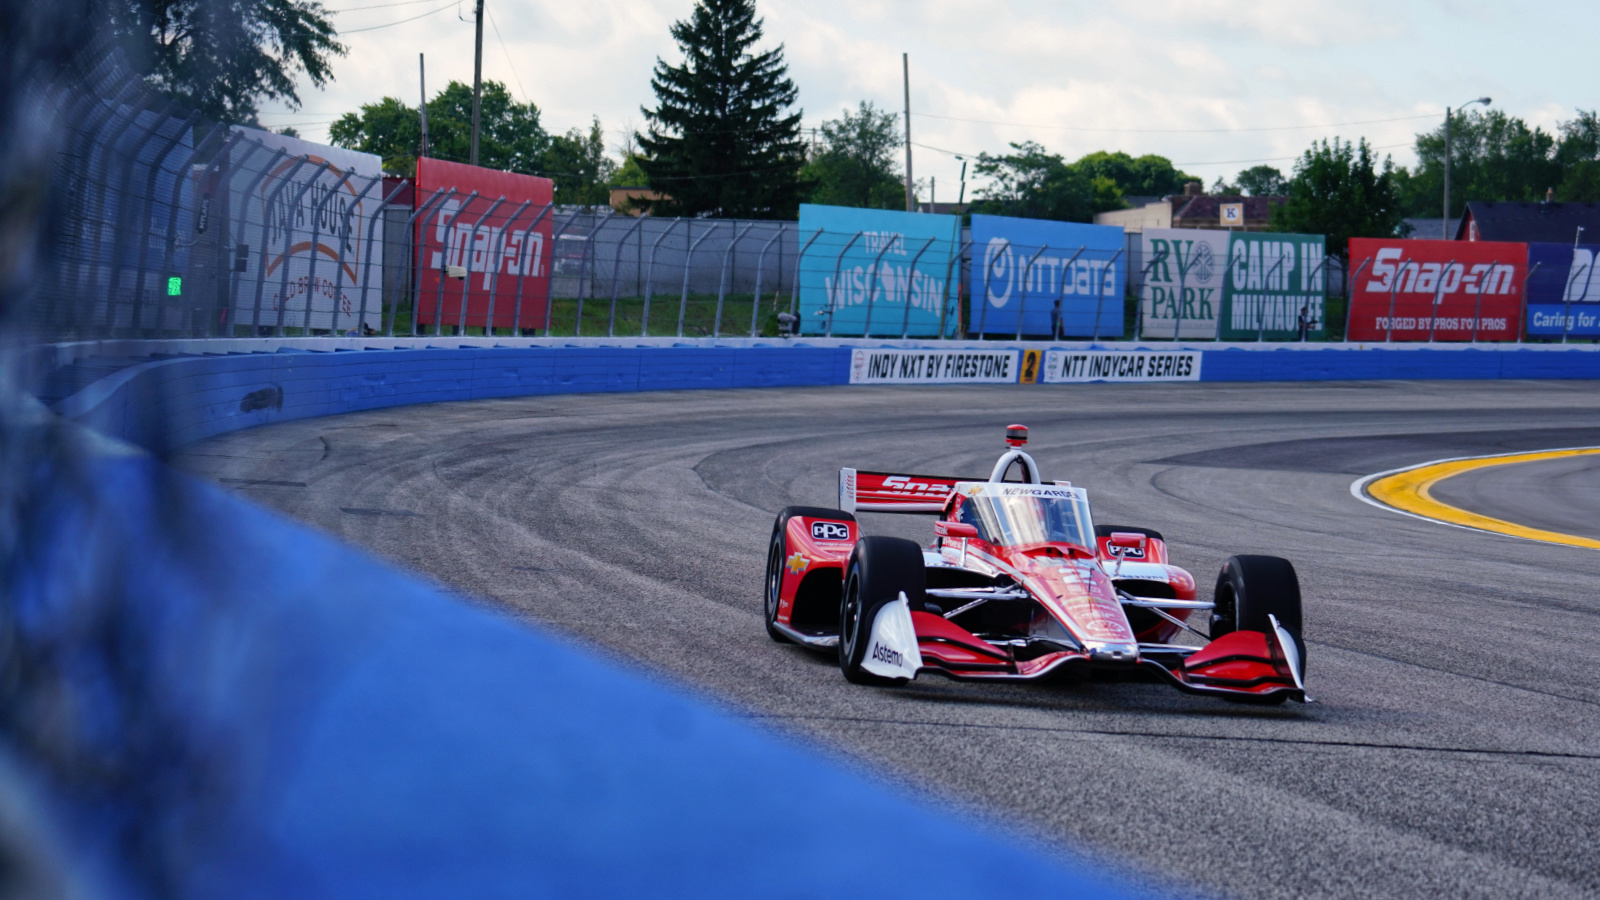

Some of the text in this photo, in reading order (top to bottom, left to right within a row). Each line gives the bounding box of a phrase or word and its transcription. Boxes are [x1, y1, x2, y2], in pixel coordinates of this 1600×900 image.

[311, 180, 354, 254] HOUSE
[1226, 208, 1236, 218] K
[431, 198, 543, 290] Snap-on
[863, 230, 908, 256] TRAVEL
[1018, 254, 1059, 293] NTT
[1150, 238, 1194, 282] RV
[1232, 239, 1322, 291] CAMP IN
[1366, 247, 1515, 304] Snap-on
[273, 281, 296, 311] CD
[298, 275, 320, 295] BRW
[1150, 287, 1214, 320] PARK
[1375, 316, 1416, 330] FORGED
[1417, 317, 1432, 330] BY
[1433, 317, 1459, 330] PROS
[1481, 318, 1506, 331] PROS
[1533, 311, 1574, 331] Caring
[1578, 311, 1596, 327] for
[867, 353, 898, 379] INDY
[898, 353, 925, 379] NXT
[926, 353, 944, 379] BY
[945, 354, 1011, 378] FIRESTONE
[1024, 351, 1037, 378] 2
[1061, 355, 1088, 377] NTT
[1087, 355, 1144, 378] INDYCAR
[1146, 354, 1194, 377] SERIES
[813, 524, 848, 538] PPG
[872, 641, 904, 667] Astemo
